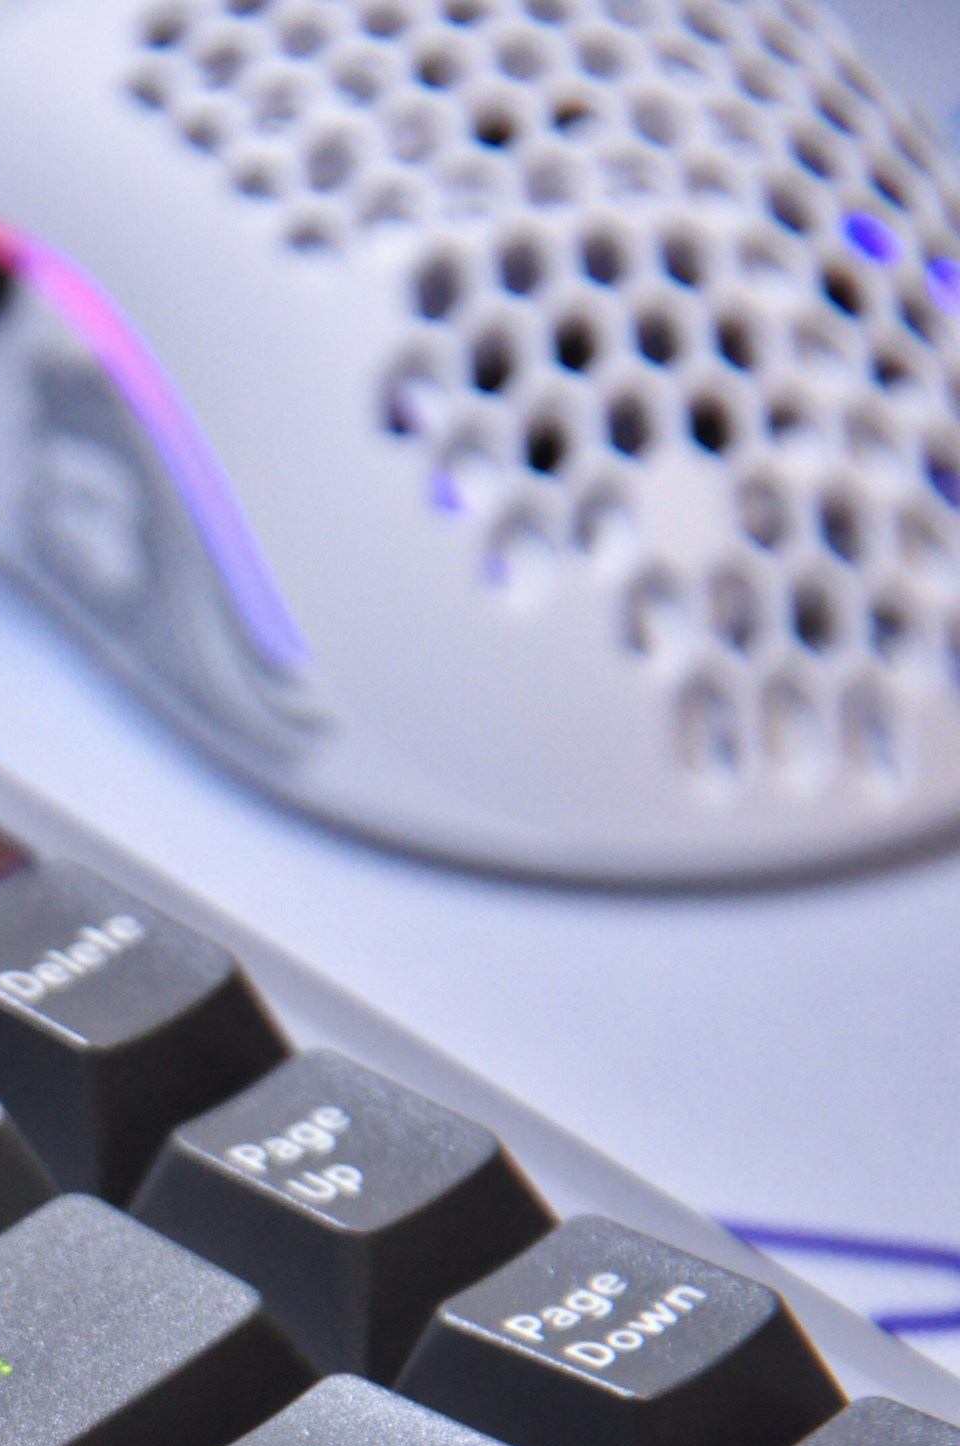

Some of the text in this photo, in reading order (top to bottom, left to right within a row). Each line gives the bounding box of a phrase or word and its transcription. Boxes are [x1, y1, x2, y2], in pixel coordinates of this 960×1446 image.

[227, 1105, 351, 1172] Page
[286, 1163, 364, 1202] Up
[502, 1271, 627, 1342] Page
[562, 1284, 708, 1368] Down
